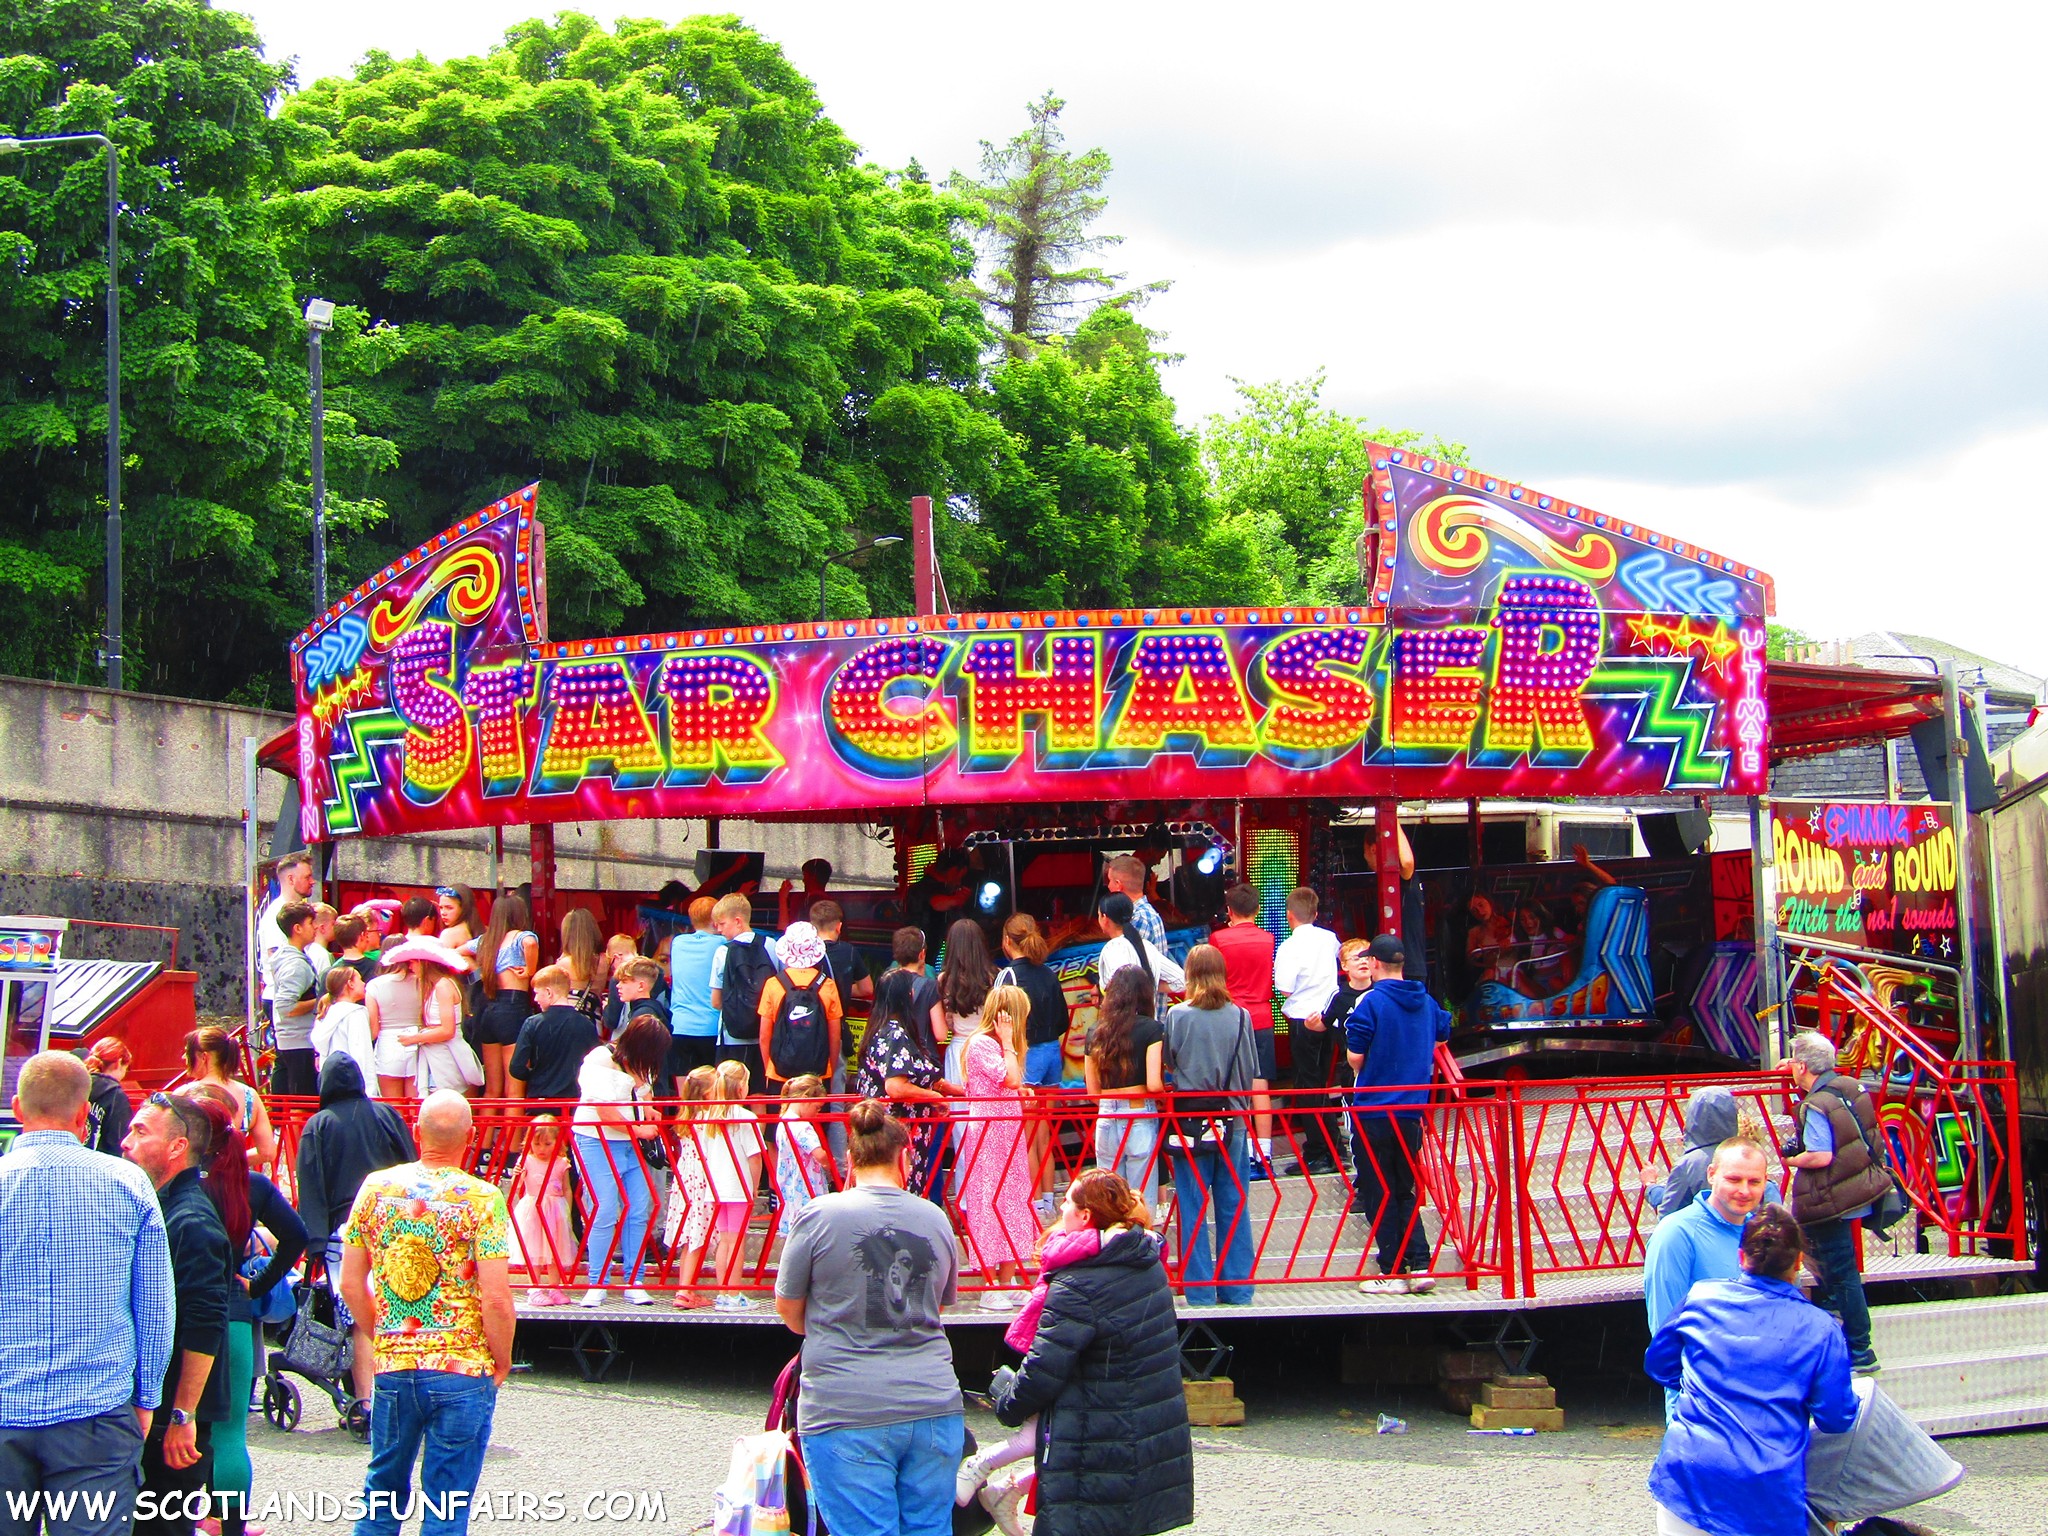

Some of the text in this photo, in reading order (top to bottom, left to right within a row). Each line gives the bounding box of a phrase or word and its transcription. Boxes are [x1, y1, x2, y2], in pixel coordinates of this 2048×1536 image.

[392, 568, 1604, 804] STAR CHASER
[1735, 628, 1766, 773] ULTIMATE
[299, 716, 320, 841] SPIN
[1824, 804, 1910, 847] SPINNING
[1772, 818, 1845, 894] ROUND
[1852, 851, 1888, 890] and
[1894, 826, 1957, 892] ROUND
[1784, 896, 1829, 933] With
[1835, 897, 1861, 932] the
[1901, 898, 1955, 930] sounds
